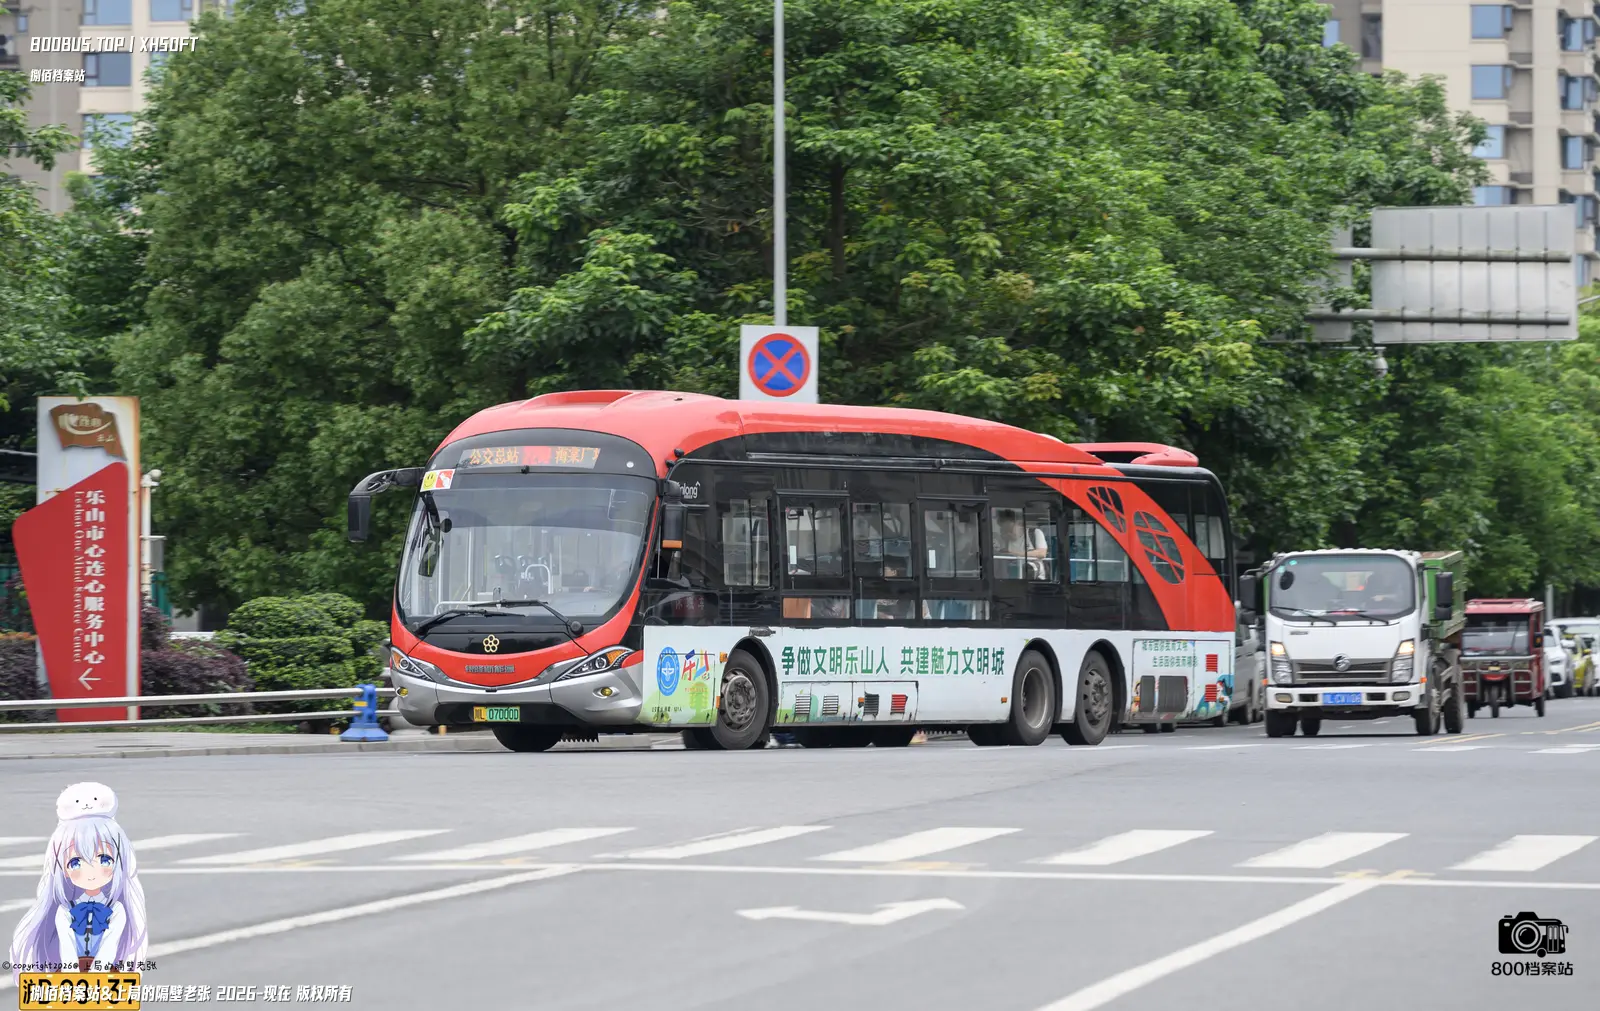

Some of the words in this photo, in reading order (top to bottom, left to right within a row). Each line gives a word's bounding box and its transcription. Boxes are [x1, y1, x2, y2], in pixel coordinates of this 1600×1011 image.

[469, 447, 519, 465] 公交总站
[73, 490, 85, 528] Leshan
[73, 529, 85, 552] One
[73, 555, 85, 583] Mind
[83, 489, 107, 665] 乐山市心连心服务中心
[73, 586, 85, 625] Service
[73, 627, 85, 664] Center
[781, 645, 890, 676] 争做文明乐山人
[900, 645, 1005, 676] 共建魅力文明城
